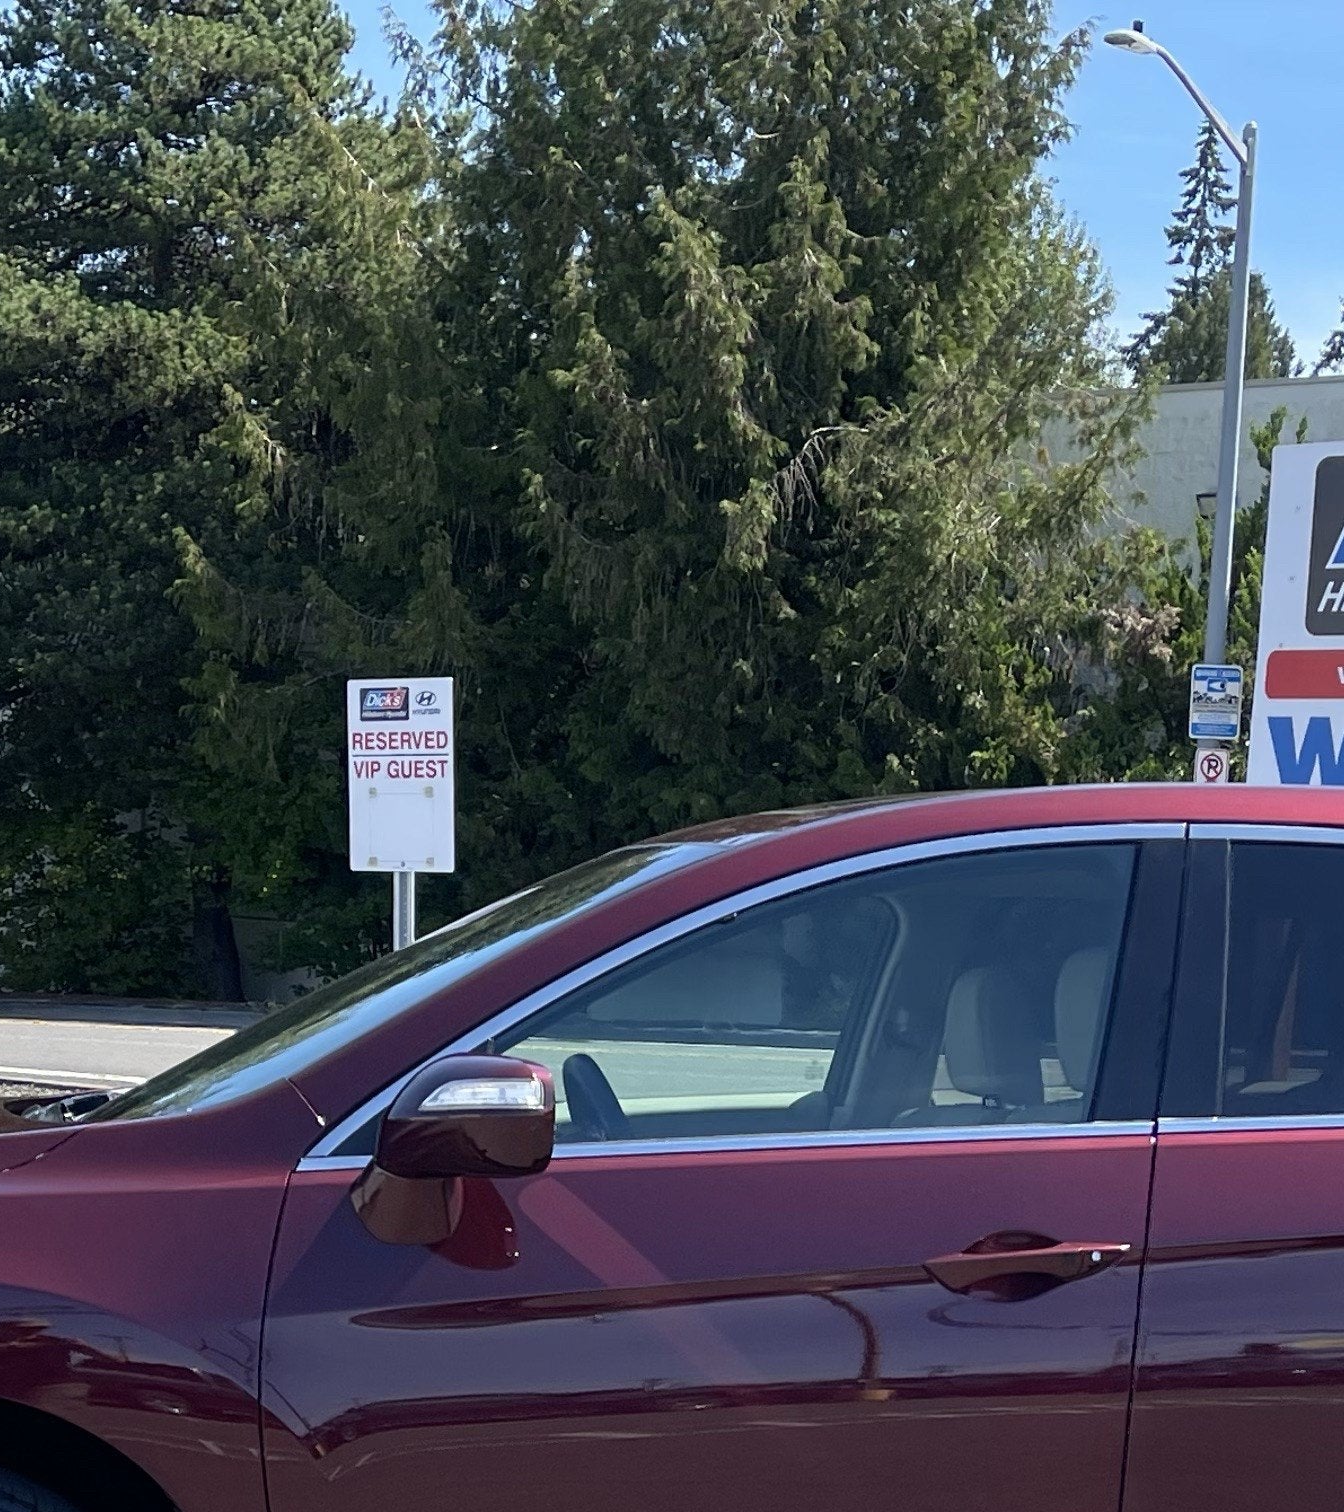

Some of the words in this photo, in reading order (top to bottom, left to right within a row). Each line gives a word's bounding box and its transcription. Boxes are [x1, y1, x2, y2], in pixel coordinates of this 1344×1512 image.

[352, 731, 448, 750] RESERVED
[353, 761, 381, 779] VIP
[387, 760, 448, 778] GUEST
